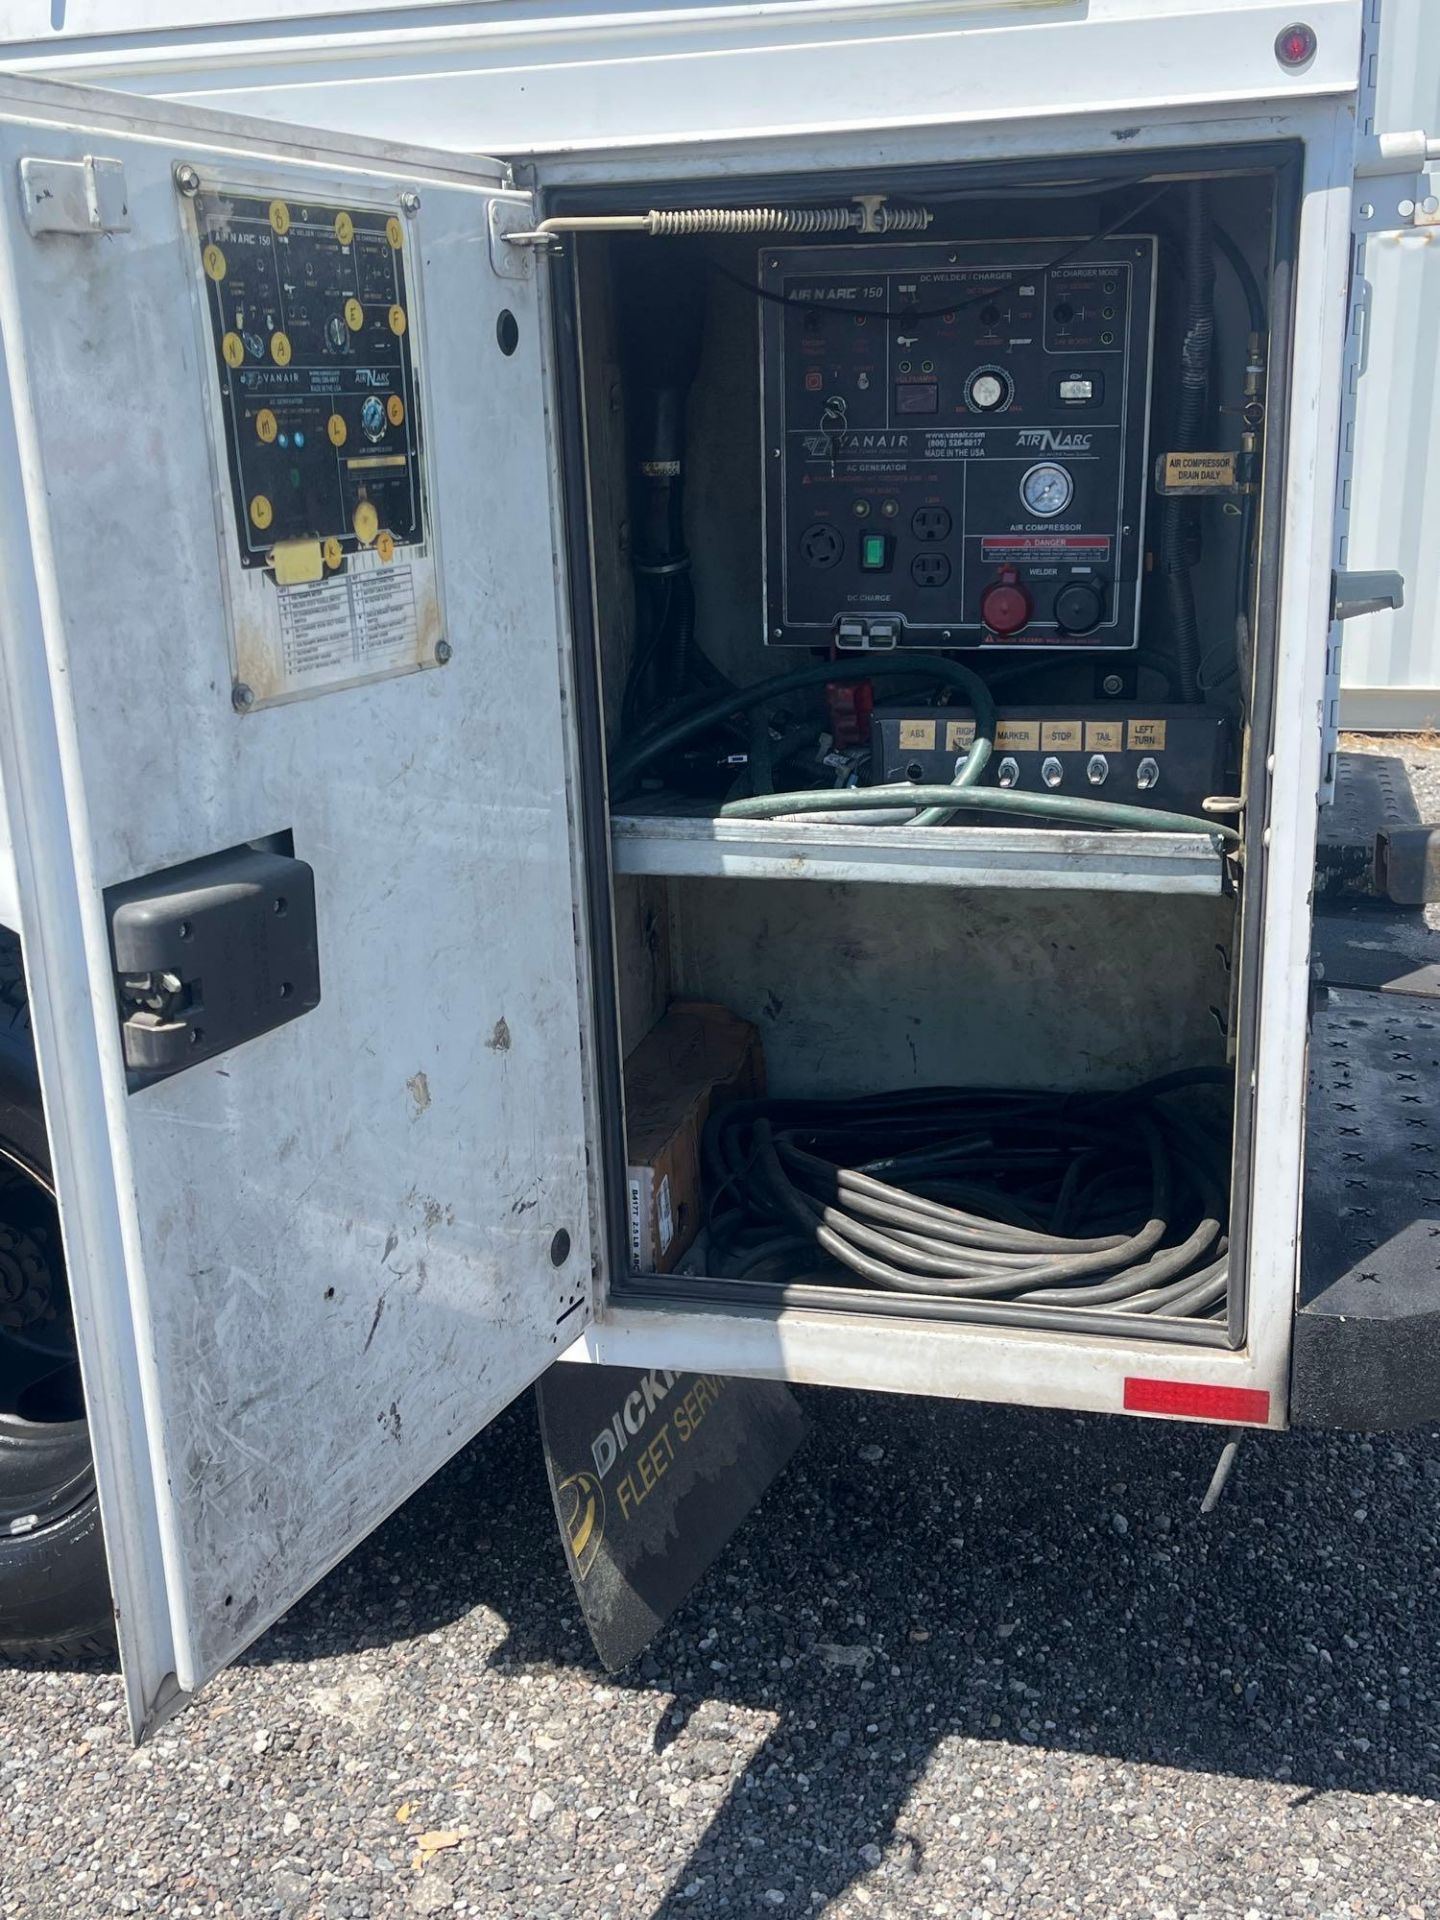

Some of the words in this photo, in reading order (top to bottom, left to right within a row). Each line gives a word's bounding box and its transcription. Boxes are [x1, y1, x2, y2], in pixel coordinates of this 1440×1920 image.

[258, 234, 271, 246] 150
[920, 274, 932, 282] DC
[932, 273, 966, 282] WELDER
[973, 272, 1012, 281] CHARGER
[789, 289, 811, 300] AIR
[814, 288, 825, 300] N
[826, 288, 856, 299] ARC
[862, 287, 883, 299] 150
[263, 373, 299, 383] VANAIR
[839, 434, 909, 447] VANAIR
[924, 448, 945, 457] MADE
[945, 448, 954, 457] IN
[955, 448, 969, 457] THE
[970, 448, 985, 457] USA
[859, 463, 907, 472] GENERATOR
[1170, 459, 1182, 468] AIR
[1182, 458, 1230, 468] COMPRESSOR
[1178, 470, 1199, 480] DRAIN
[1200, 470, 1221, 480] DAILY
[1025, 523, 1082, 531] COMPRESSOR
[1029, 567, 1058, 576] WELDER
[847, 594, 858, 602] DC
[859, 594, 891, 602] CHARGE
[956, 727, 976, 735] RIGH
[1134, 725, 1155, 734] LEFT
[997, 731, 1030, 741] MARKER
[1051, 731, 1072, 741] STOP
[1095, 732, 1112, 742] TAIL
[1134, 735, 1155, 745] TURN
[957, 737, 973, 746] TUR
[616, 1423, 675, 1521] FLEET
